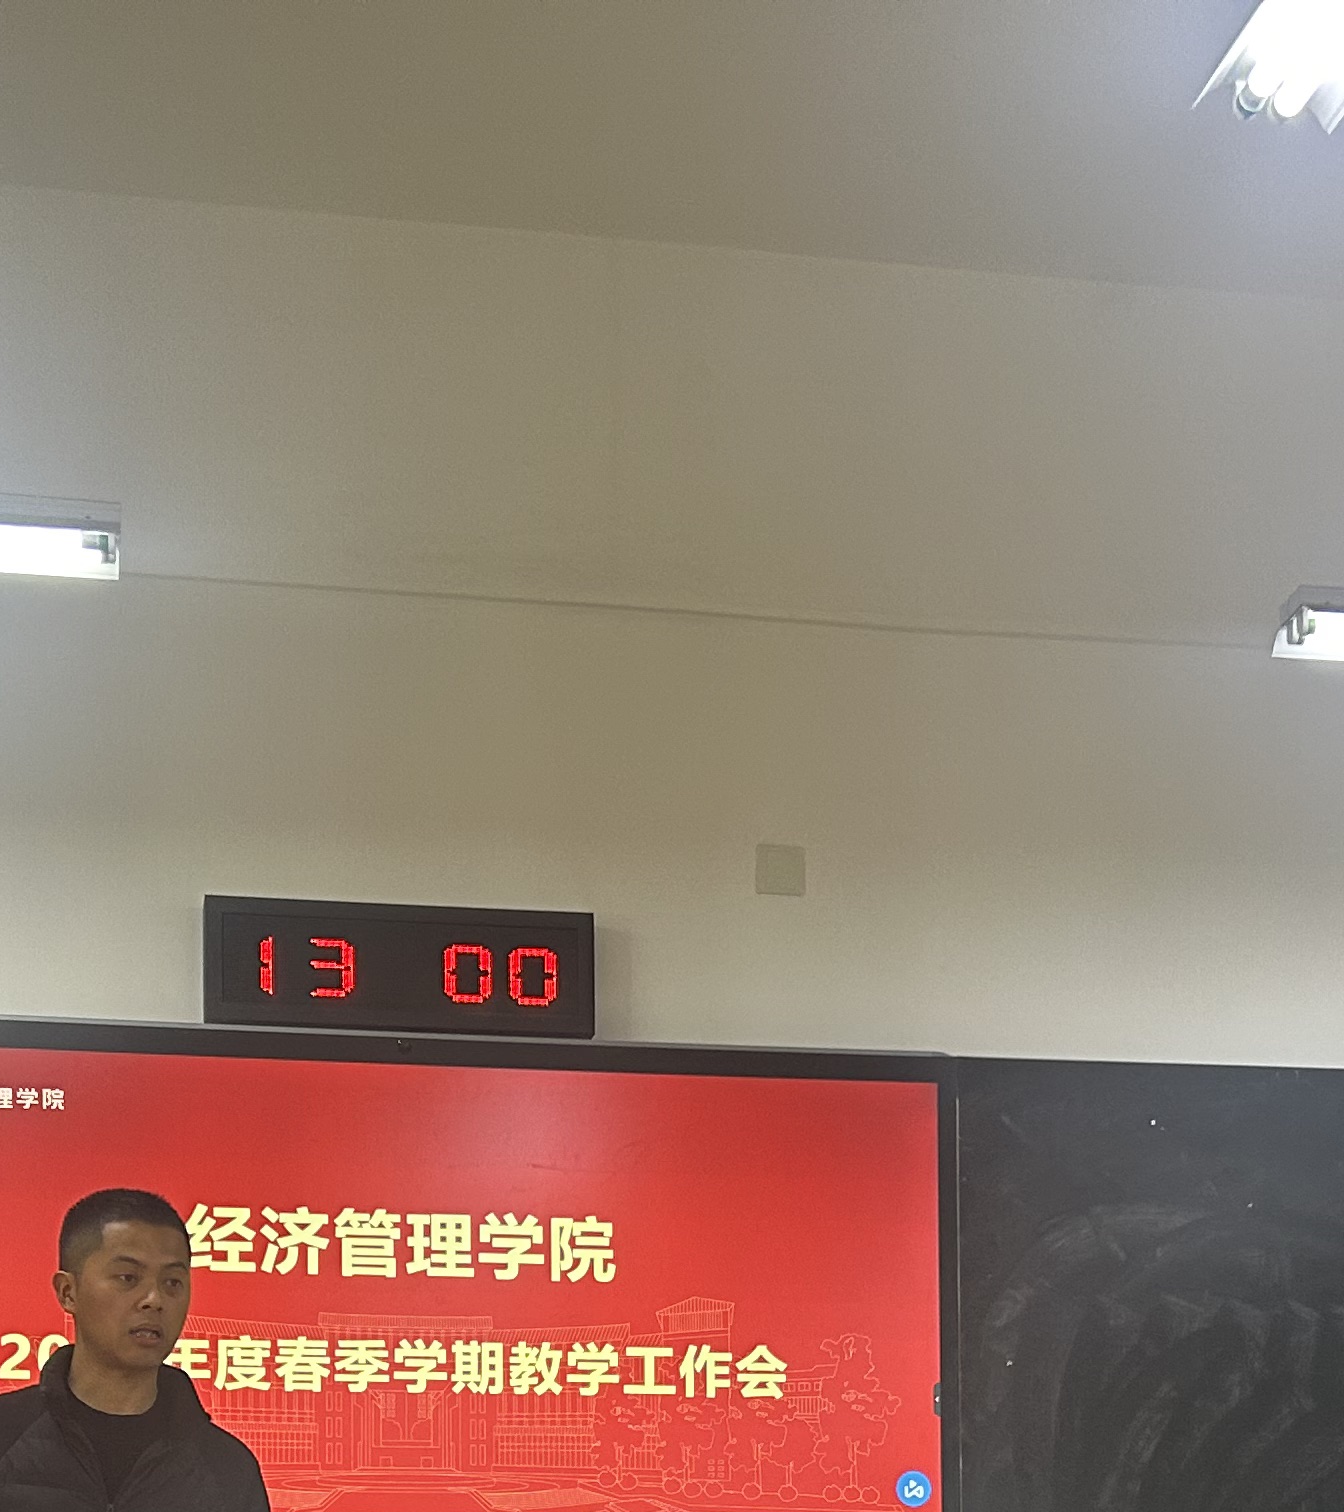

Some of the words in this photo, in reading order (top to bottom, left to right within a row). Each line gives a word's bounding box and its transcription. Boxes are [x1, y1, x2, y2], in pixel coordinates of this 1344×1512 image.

[258, 935, 357, 998] 13
[441, 943, 559, 1007] 00
[186, 1203, 617, 1283] 经济管理学院
